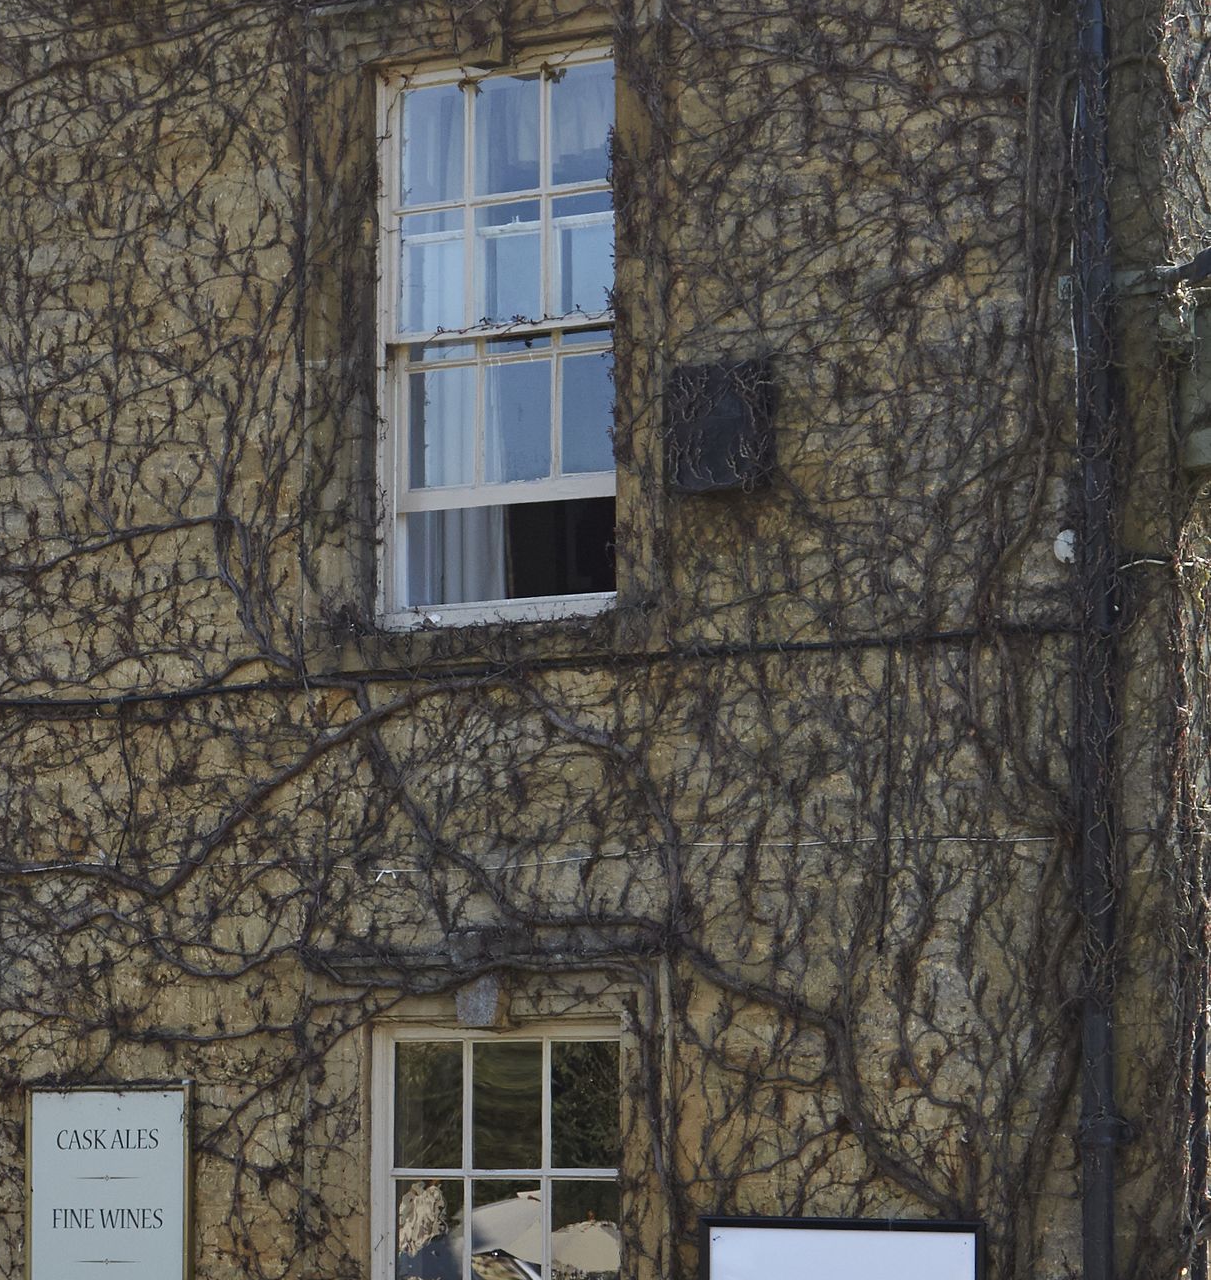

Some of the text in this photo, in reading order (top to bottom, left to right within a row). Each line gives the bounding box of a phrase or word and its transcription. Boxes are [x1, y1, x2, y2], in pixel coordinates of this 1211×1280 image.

[56, 1128, 159, 1150] CASK ALES
[52, 1208, 163, 1229] FINE WINES
